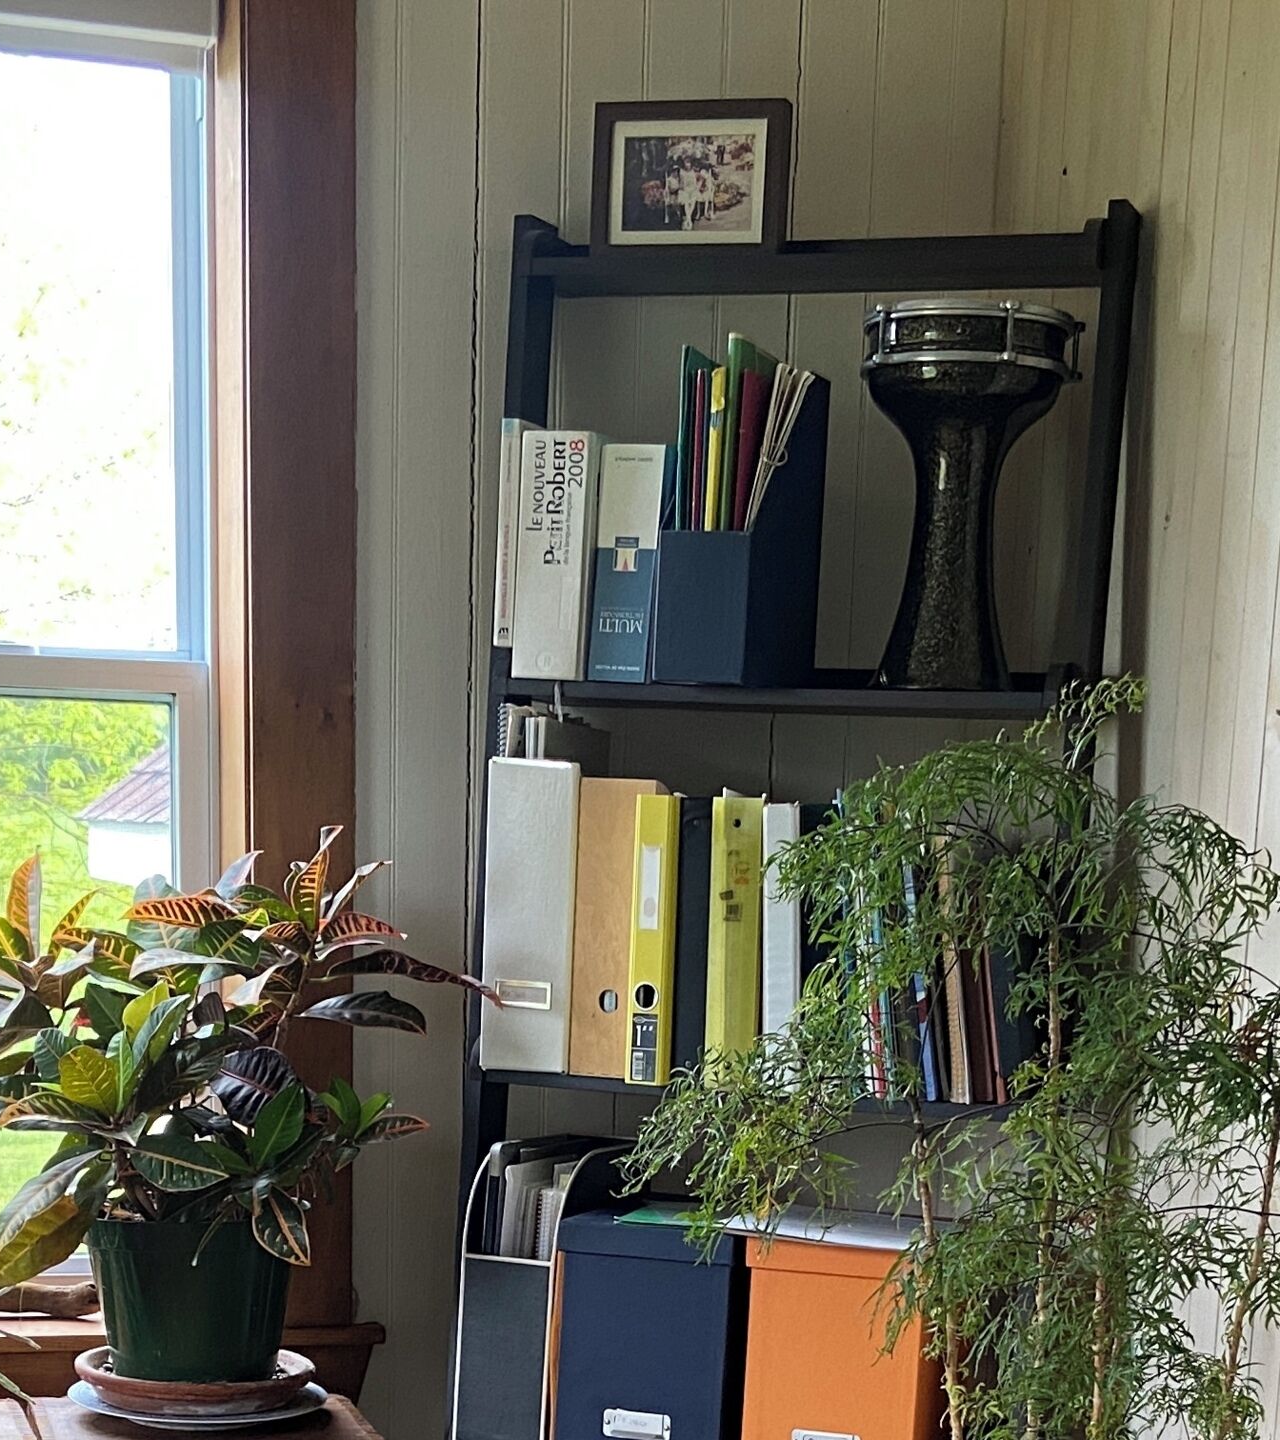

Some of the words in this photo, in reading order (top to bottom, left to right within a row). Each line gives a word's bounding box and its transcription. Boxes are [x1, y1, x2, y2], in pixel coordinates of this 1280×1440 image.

[533, 439, 548, 515] NOUVEAU
[567, 438, 586, 489] 2008
[598, 618, 643, 635] MULTI
